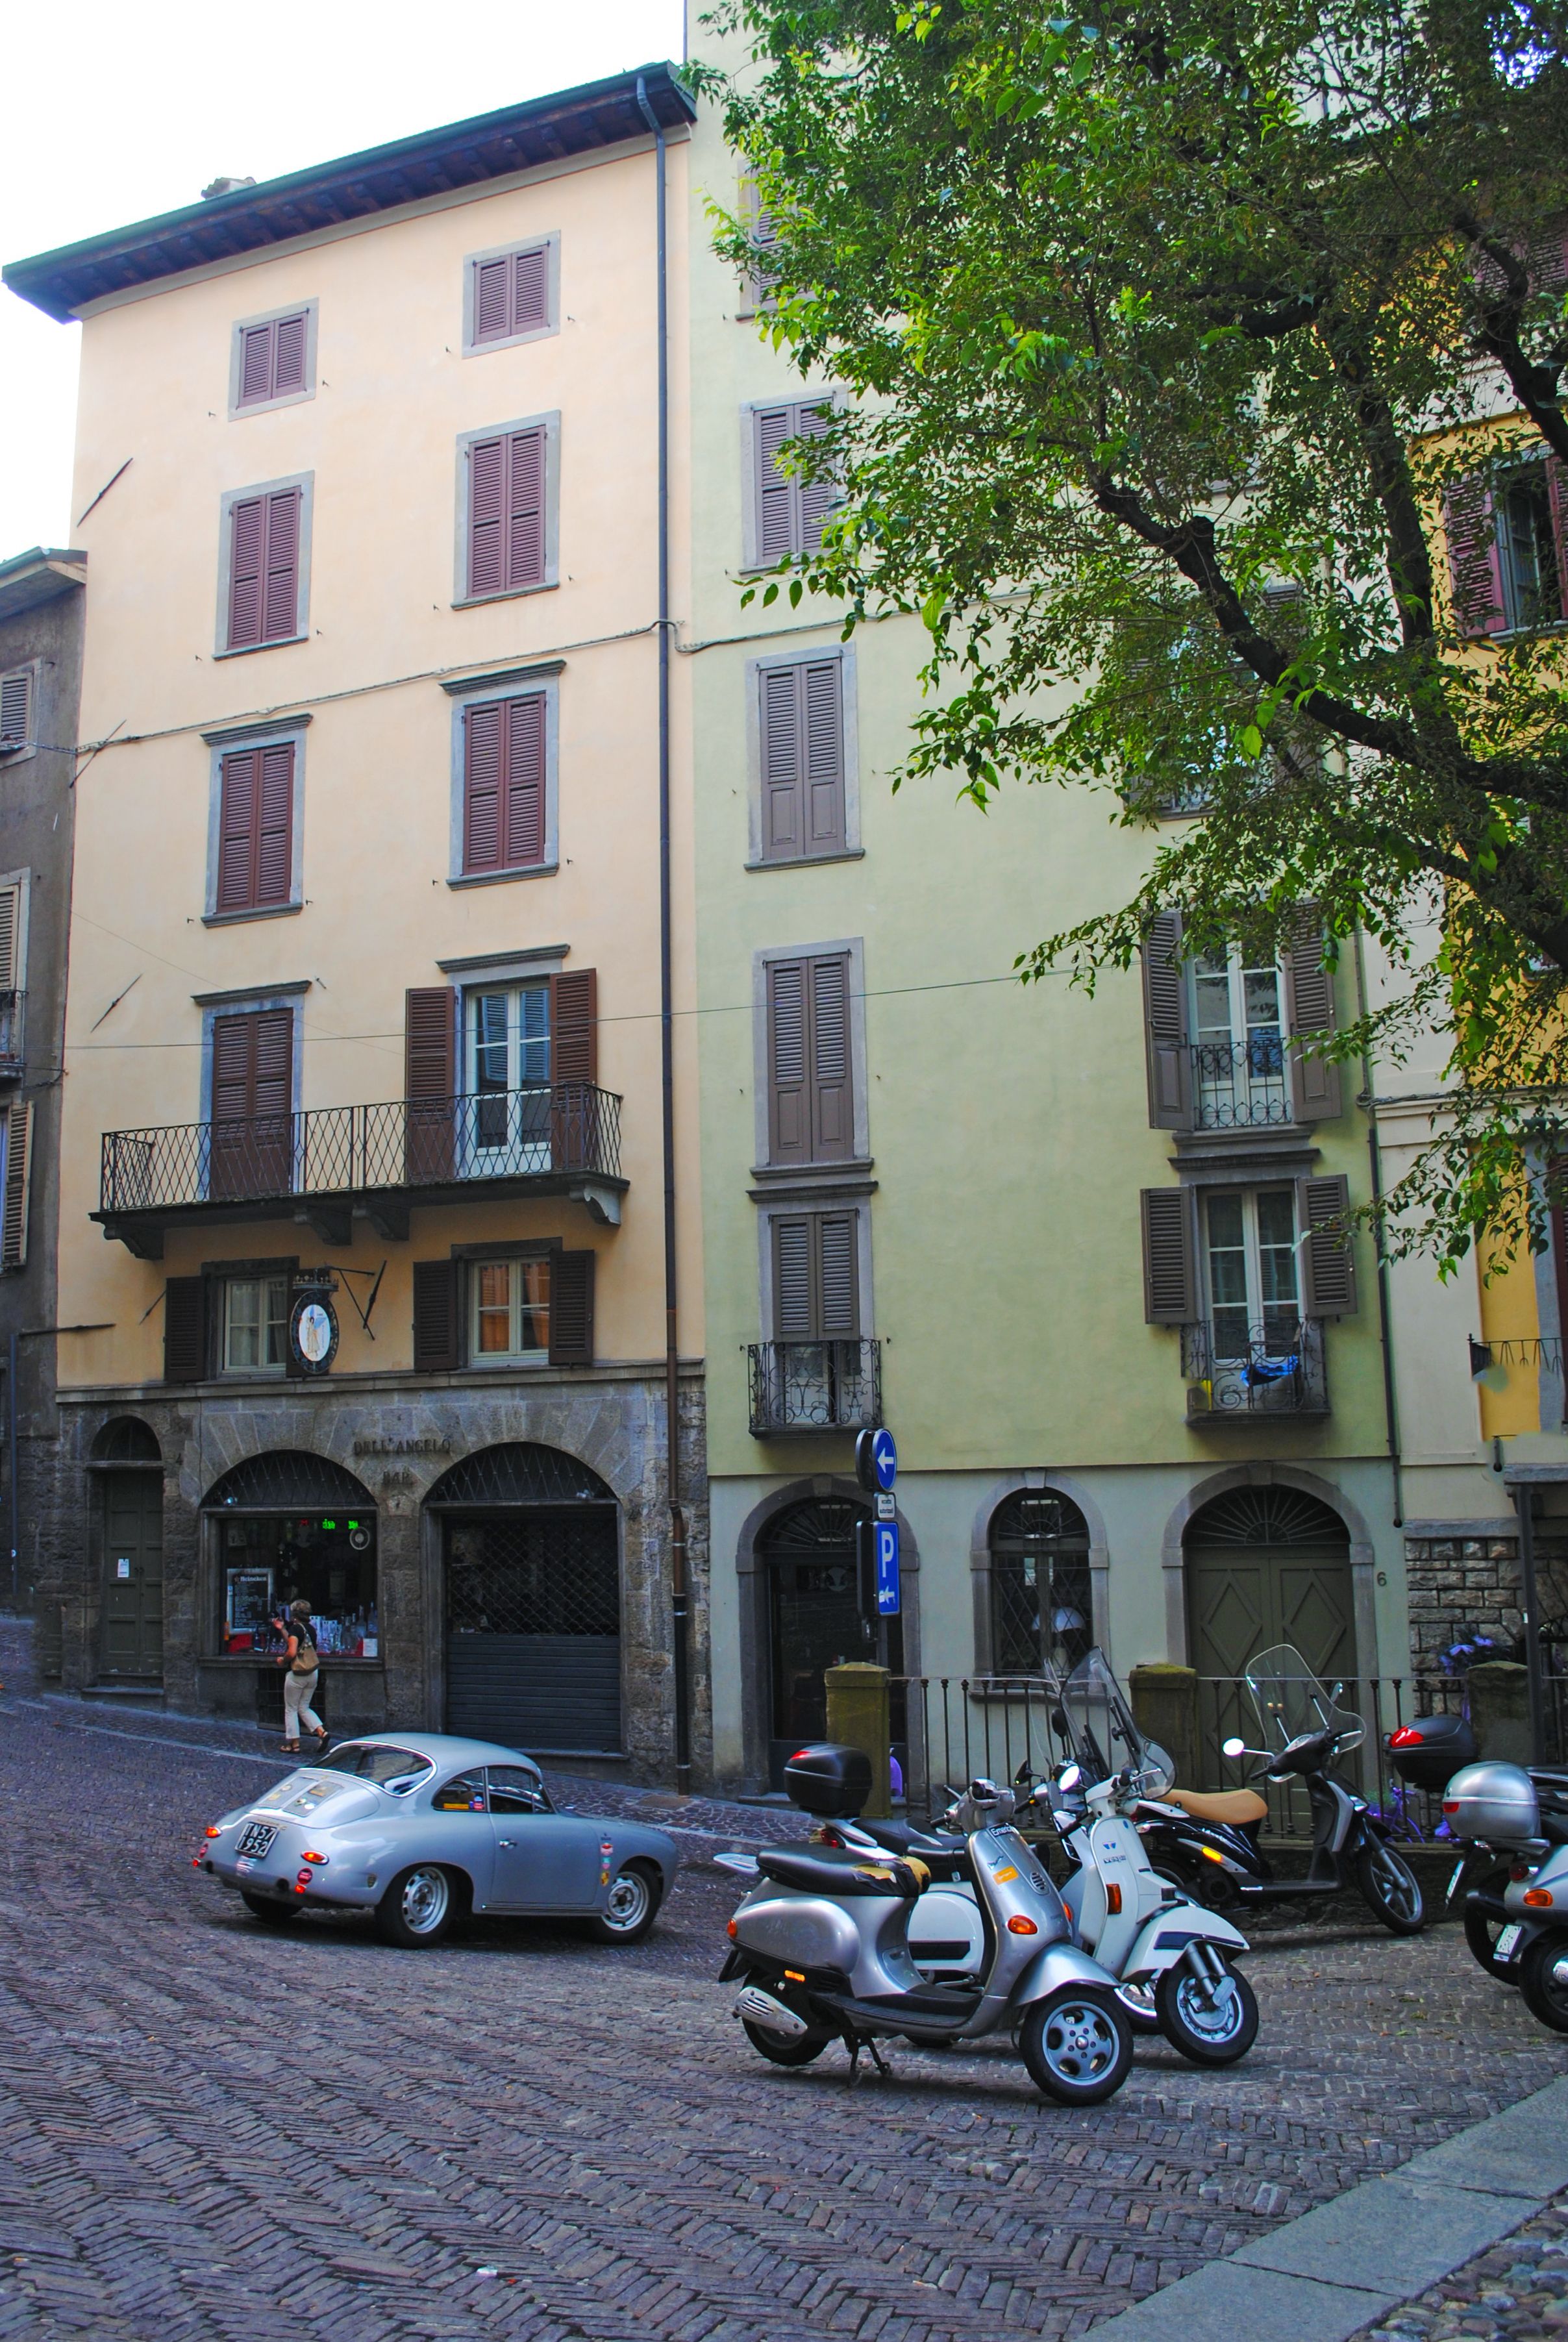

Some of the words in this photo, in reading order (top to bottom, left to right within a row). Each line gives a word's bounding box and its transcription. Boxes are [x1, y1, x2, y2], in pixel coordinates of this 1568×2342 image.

[383, 1471, 414, 1485] BAR
[881, 1531, 894, 1578] P
[1376, 1571, 1387, 1587] 6
[238, 1837, 268, 1854] 1952
